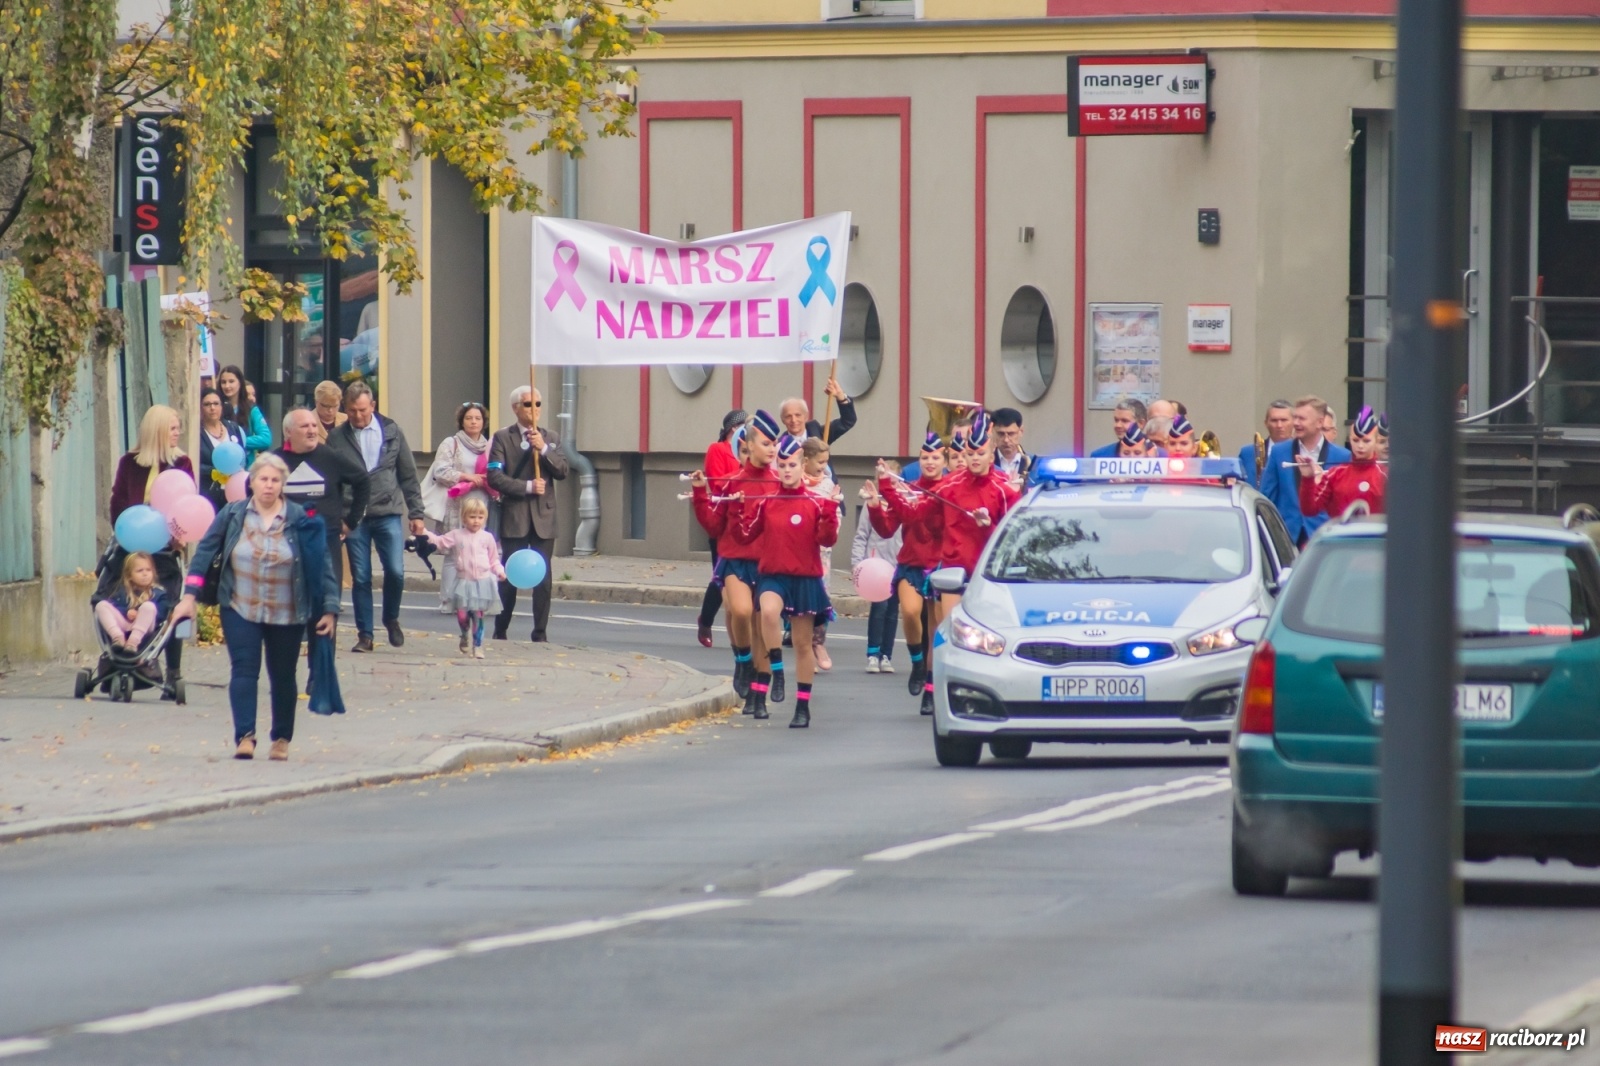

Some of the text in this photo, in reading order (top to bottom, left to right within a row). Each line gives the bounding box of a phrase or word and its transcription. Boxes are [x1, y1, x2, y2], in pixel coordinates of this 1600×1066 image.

[1084, 74, 1164, 89] manager
[1085, 107, 1202, 121] TEL. 32 415 34 16
[136, 117, 160, 259] sense
[608, 242, 776, 285] MARSZ
[596, 298, 790, 339] NADZIEI
[1192, 319, 1225, 330] manager
[1099, 460, 1163, 475] POLICJA
[1046, 610, 1151, 623] POLICJA
[1055, 679, 1088, 696] HPP
[1095, 679, 1140, 696] R006
